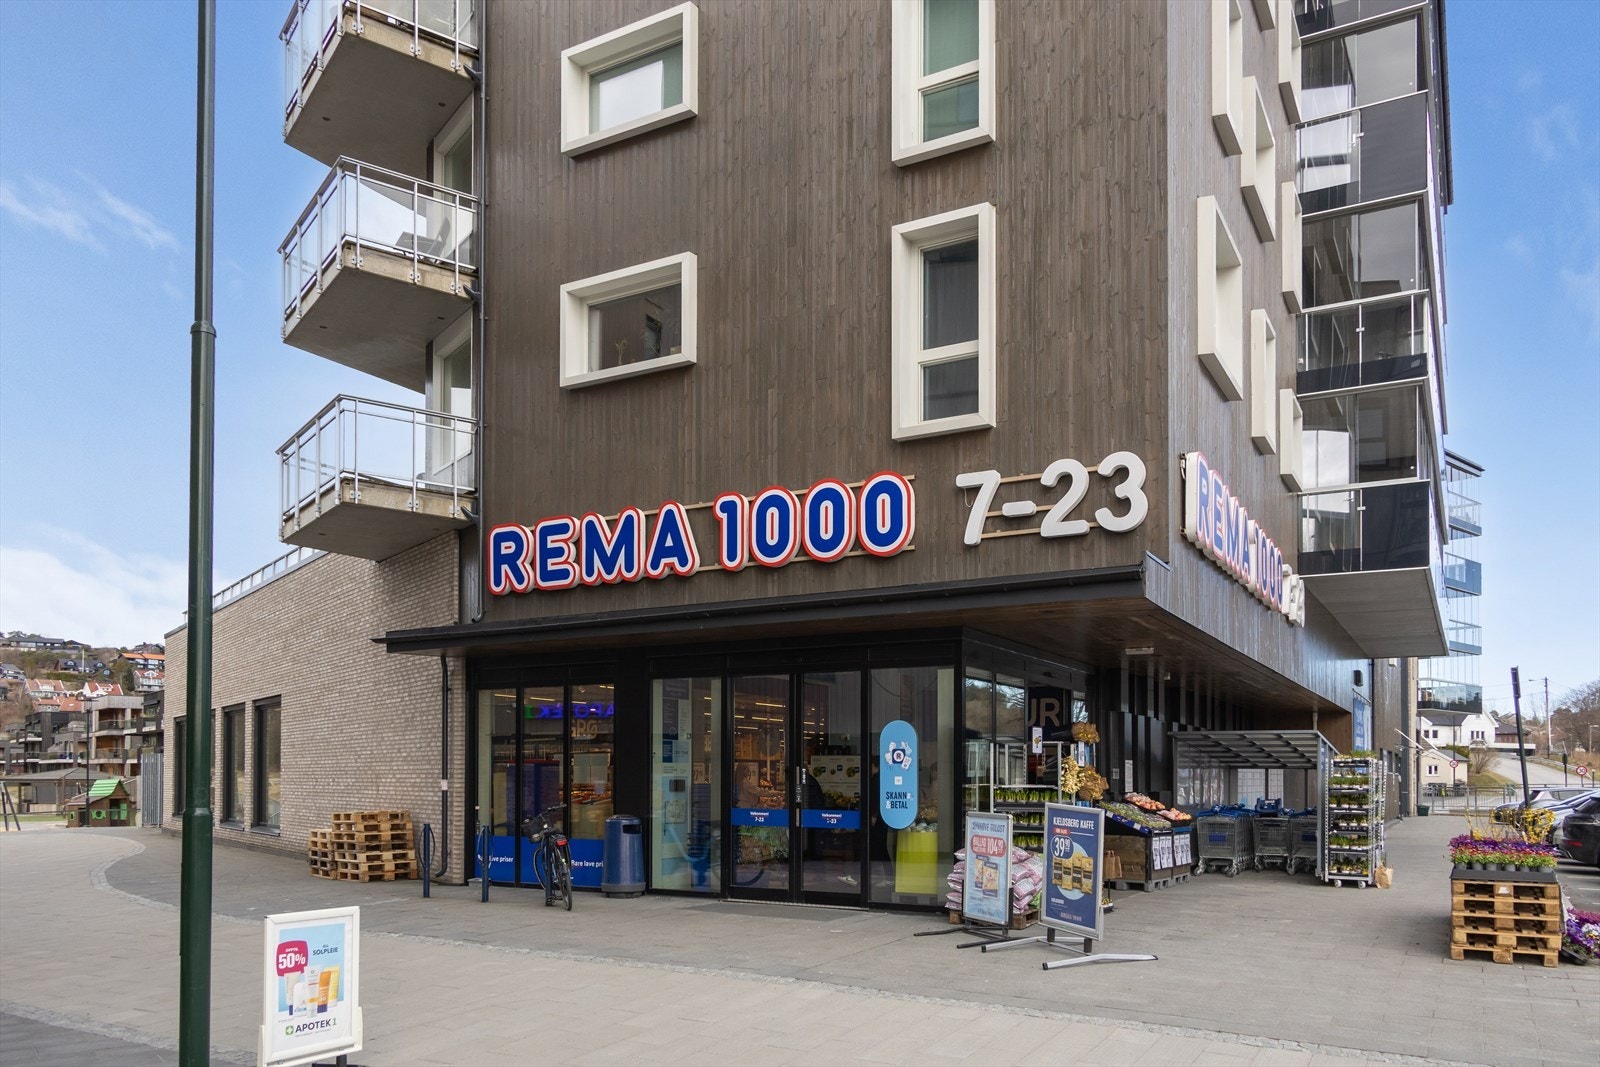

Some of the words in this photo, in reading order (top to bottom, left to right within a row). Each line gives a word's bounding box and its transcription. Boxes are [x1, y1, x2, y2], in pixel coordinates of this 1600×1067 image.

[955, 450, 1148, 546] 7-23
[488, 500, 700, 596] REMA
[713, 470, 915, 573] 1000
[1187, 452, 1251, 585] REMA
[1252, 519, 1283, 612] 1000
[885, 791, 907, 800] SKANN
[1080, 820, 1094, 830] KAFFE
[987, 838, 998, 855] 104
[1054, 837, 1065, 857] 39
[571, 859, 583, 867] Bare
[584, 859, 596, 867] lave
[312, 947, 339, 956] SOLPLEIE
[278, 952, 306, 969] 50%
[295, 1018, 331, 1033] APOTEK
[332, 1018, 337, 1026] 1
